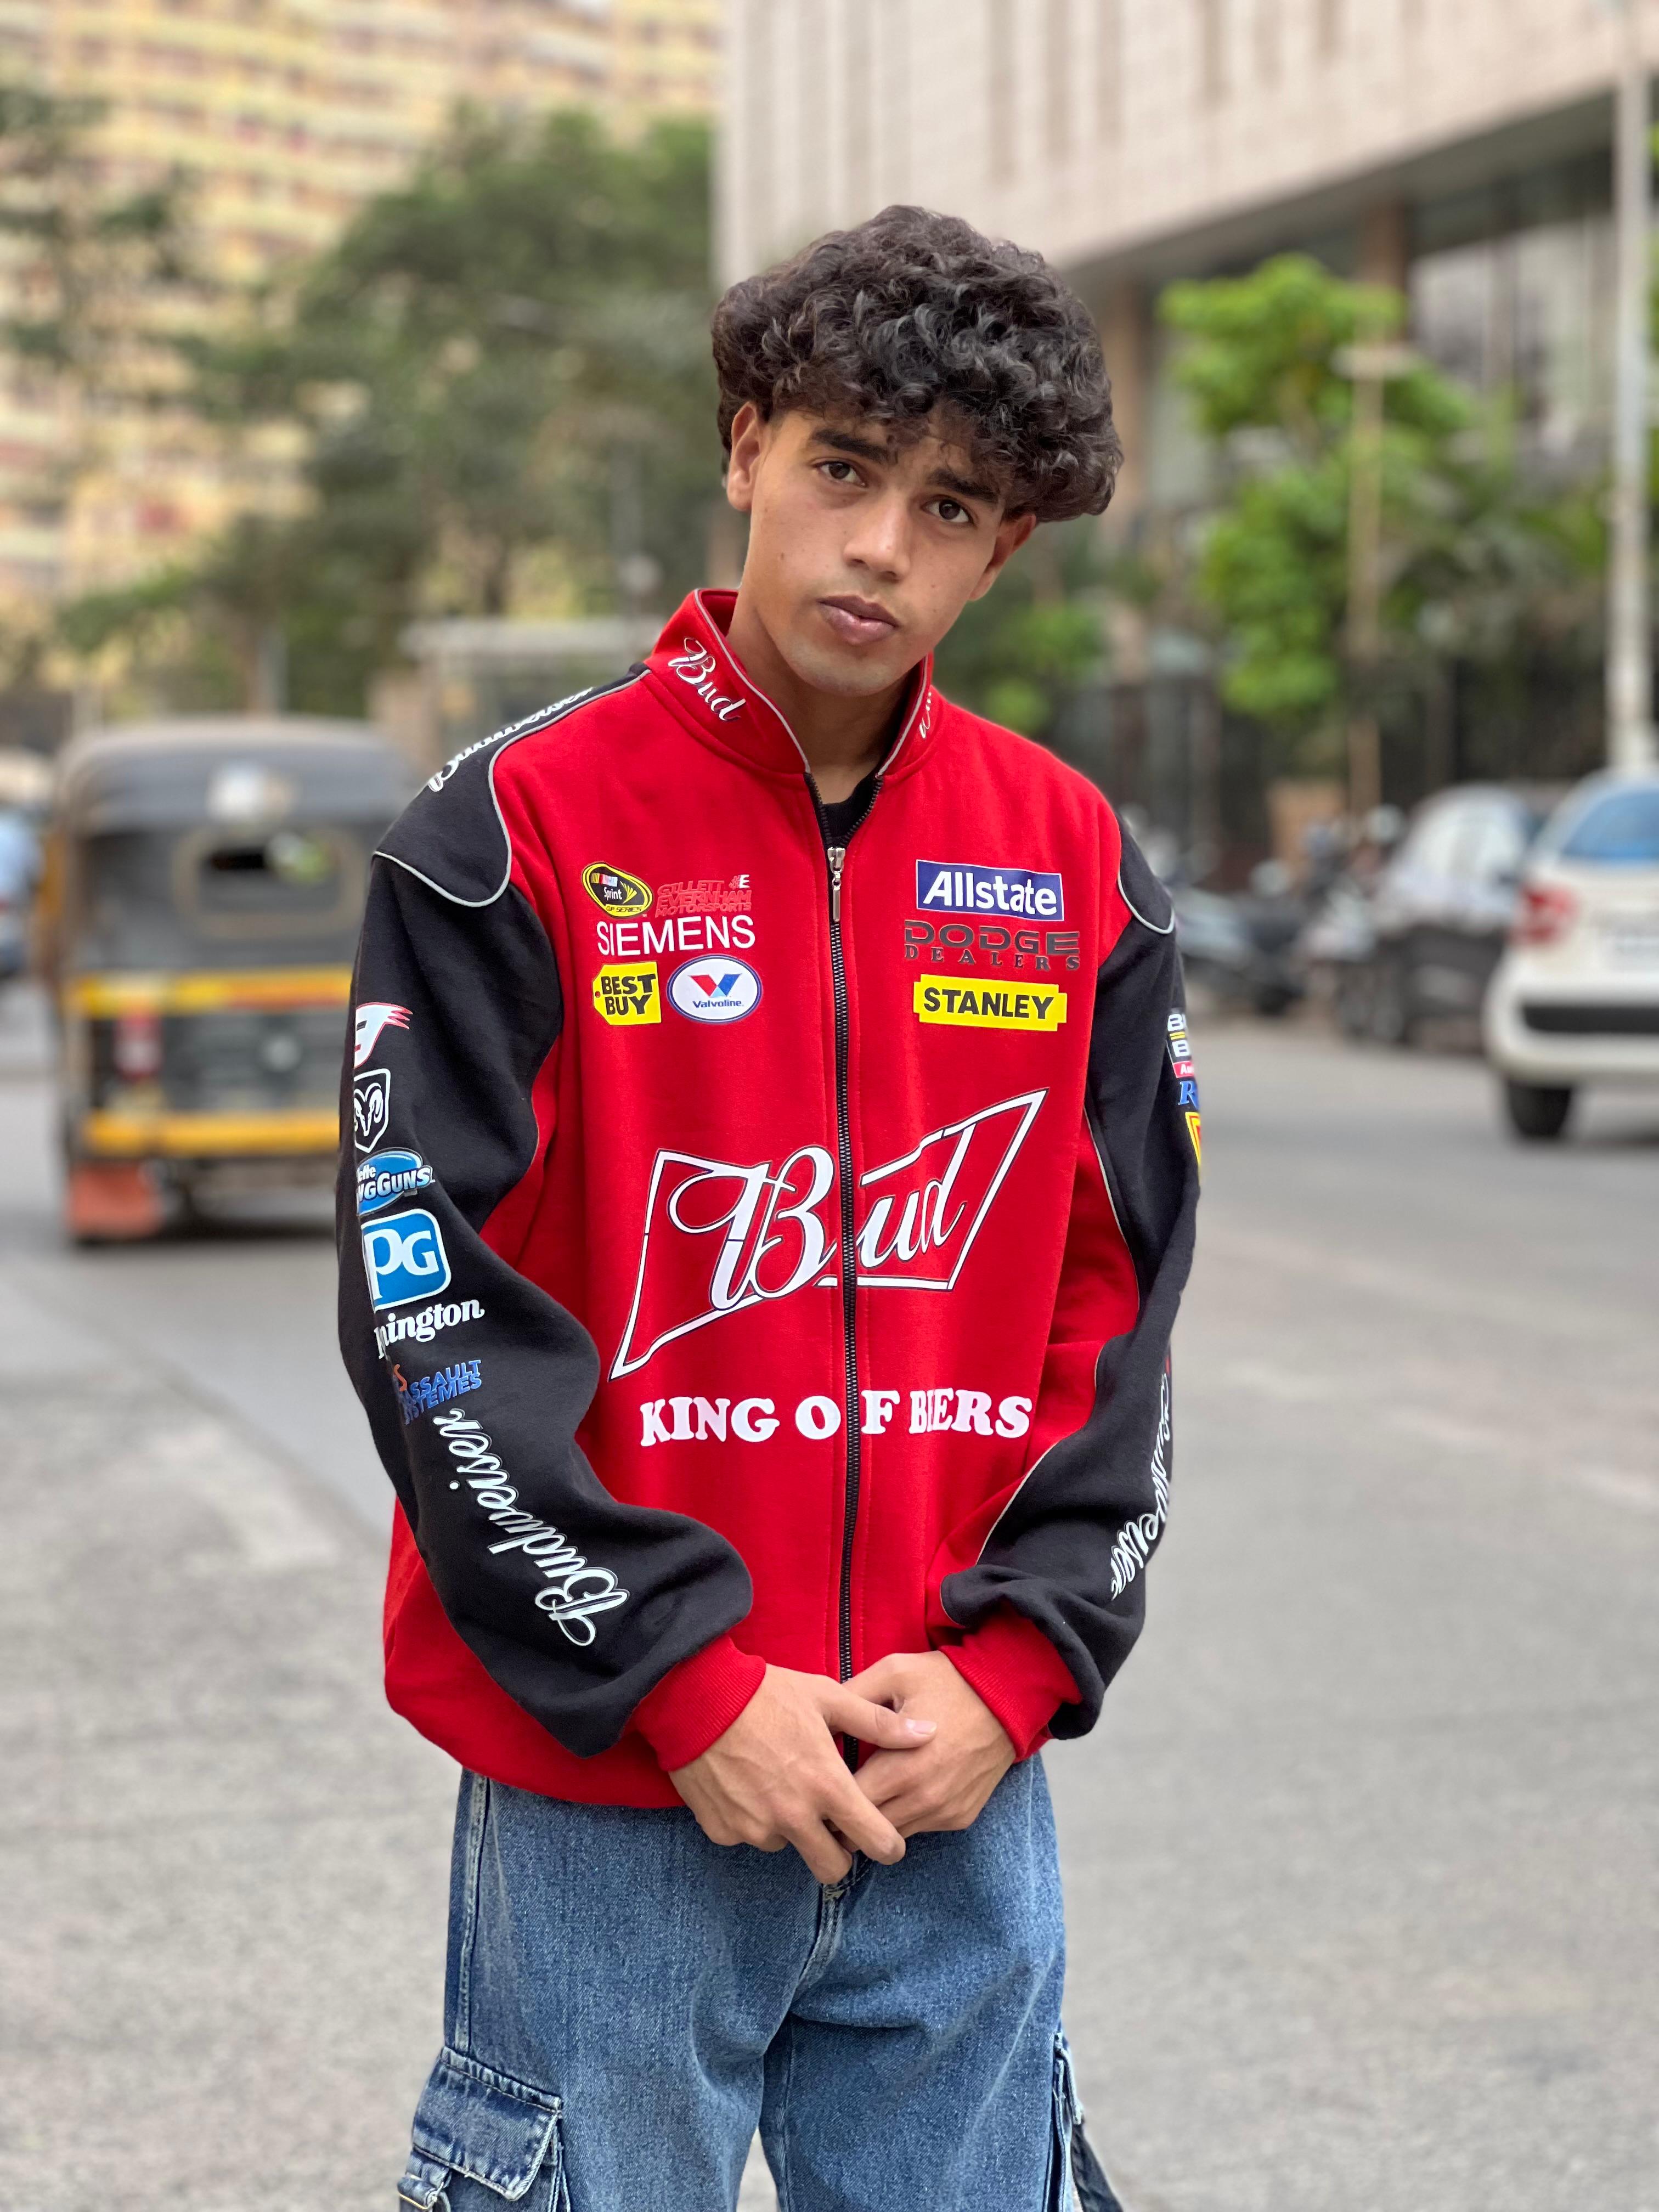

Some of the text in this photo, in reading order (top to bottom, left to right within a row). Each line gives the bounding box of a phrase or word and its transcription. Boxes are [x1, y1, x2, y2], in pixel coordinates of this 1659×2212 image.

[668, 636, 747, 722] Bud
[603, 887, 623, 900] Sprint
[657, 880, 725, 895] GILLETT
[657, 890, 752, 907] EVERNHAM
[923, 871, 1057, 916] Allstate
[655, 902, 752, 918] MOTORSPORTS
[596, 915, 755, 956] SIEMENS
[904, 919, 1080, 955] DODGE
[904, 943, 1080, 972] DEALERS
[601, 973, 657, 995] BEST
[605, 994, 652, 1015] BUY
[692, 1000, 742, 1008] Valvoline
[924, 987, 1054, 1019] STANLEY
[667, 1122, 966, 1311] Bud
[640, 1395, 780, 1447] KING
[909, 1387, 1033, 1438] BEERS
[433, 1408, 630, 1646] Budweiser
